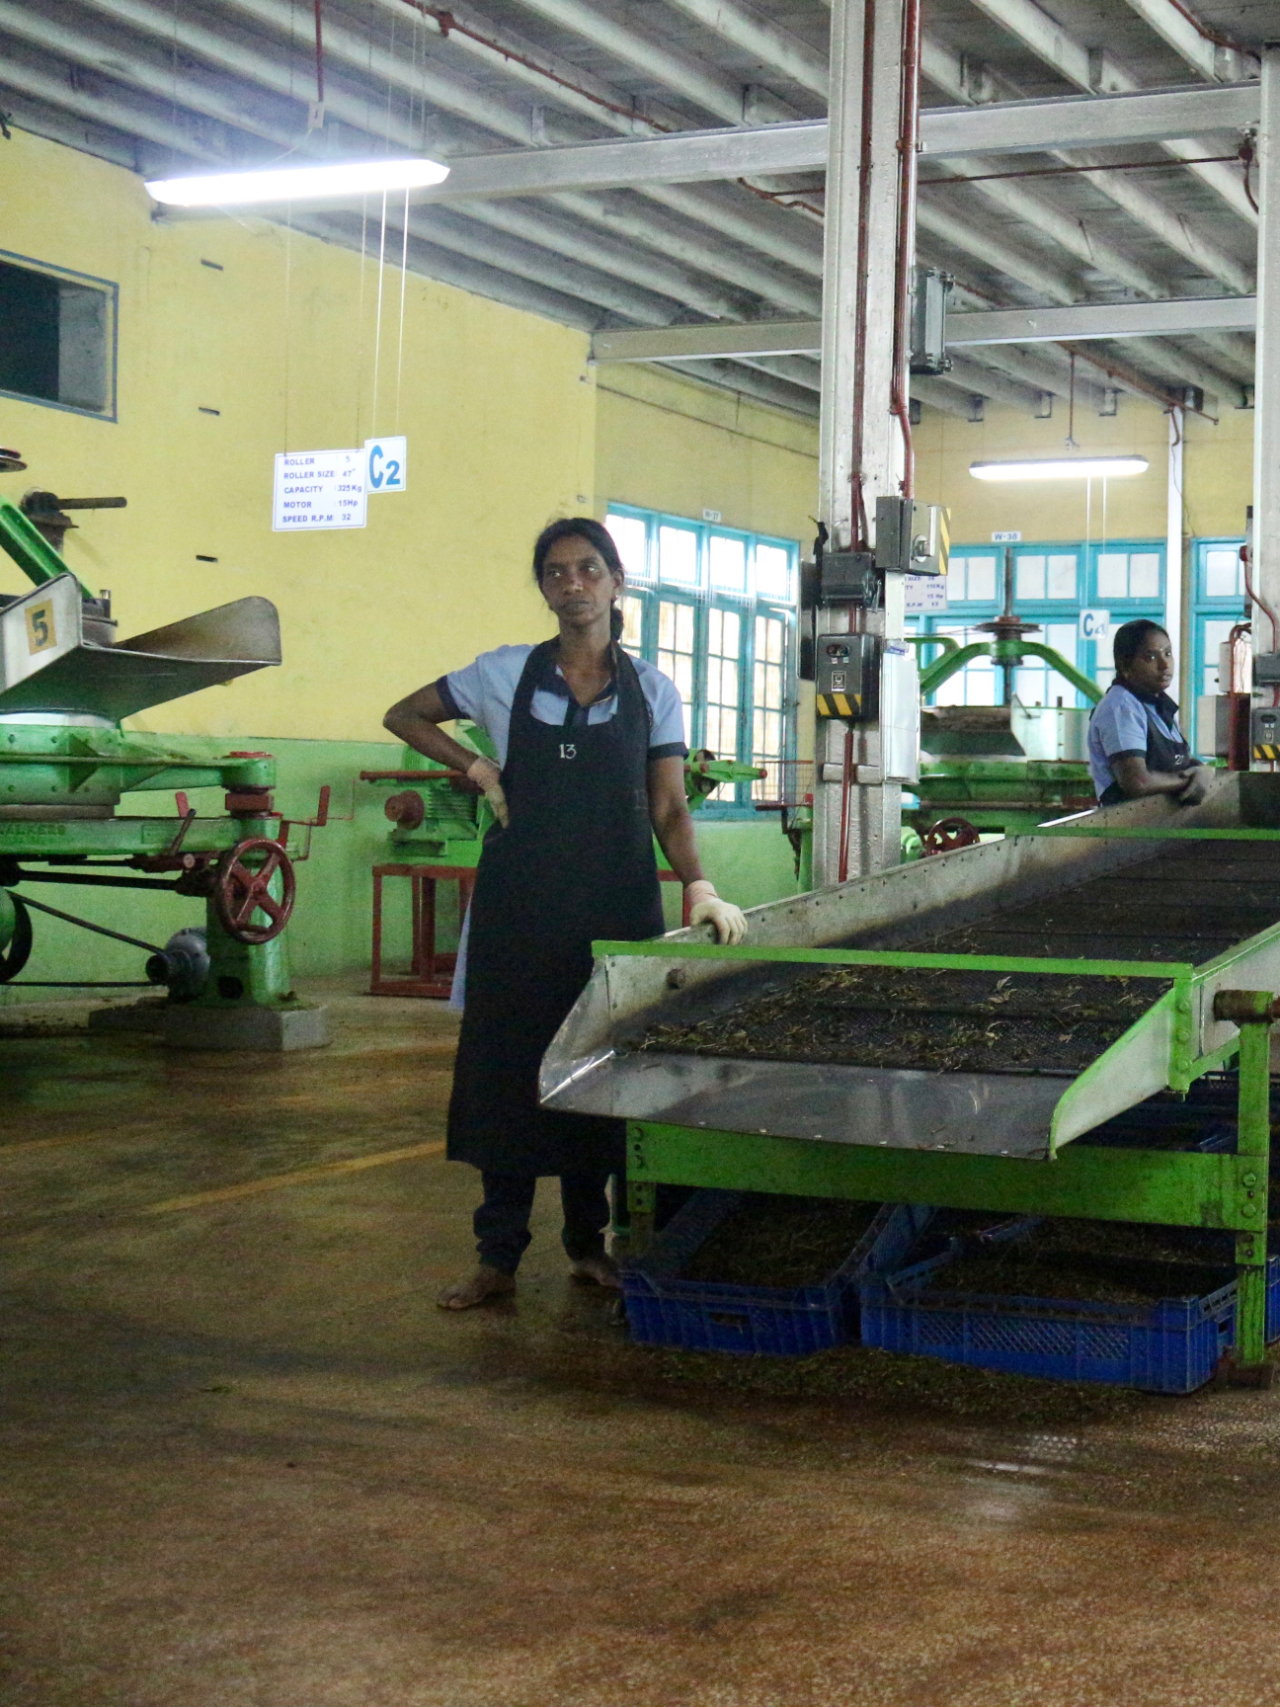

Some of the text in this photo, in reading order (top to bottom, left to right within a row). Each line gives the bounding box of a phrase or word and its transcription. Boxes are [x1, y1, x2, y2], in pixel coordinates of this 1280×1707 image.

[284, 458, 315, 466] ROLLER
[369, 444, 401, 489] C2
[283, 471, 314, 480] ROLLER
[284, 486, 323, 494] CAPACITY
[283, 501, 312, 509] MOTOR
[282, 515, 308, 523] SPEED
[341, 513, 351, 521] 32
[32, 609, 48, 646] 5
[559, 744, 577, 759] 13
